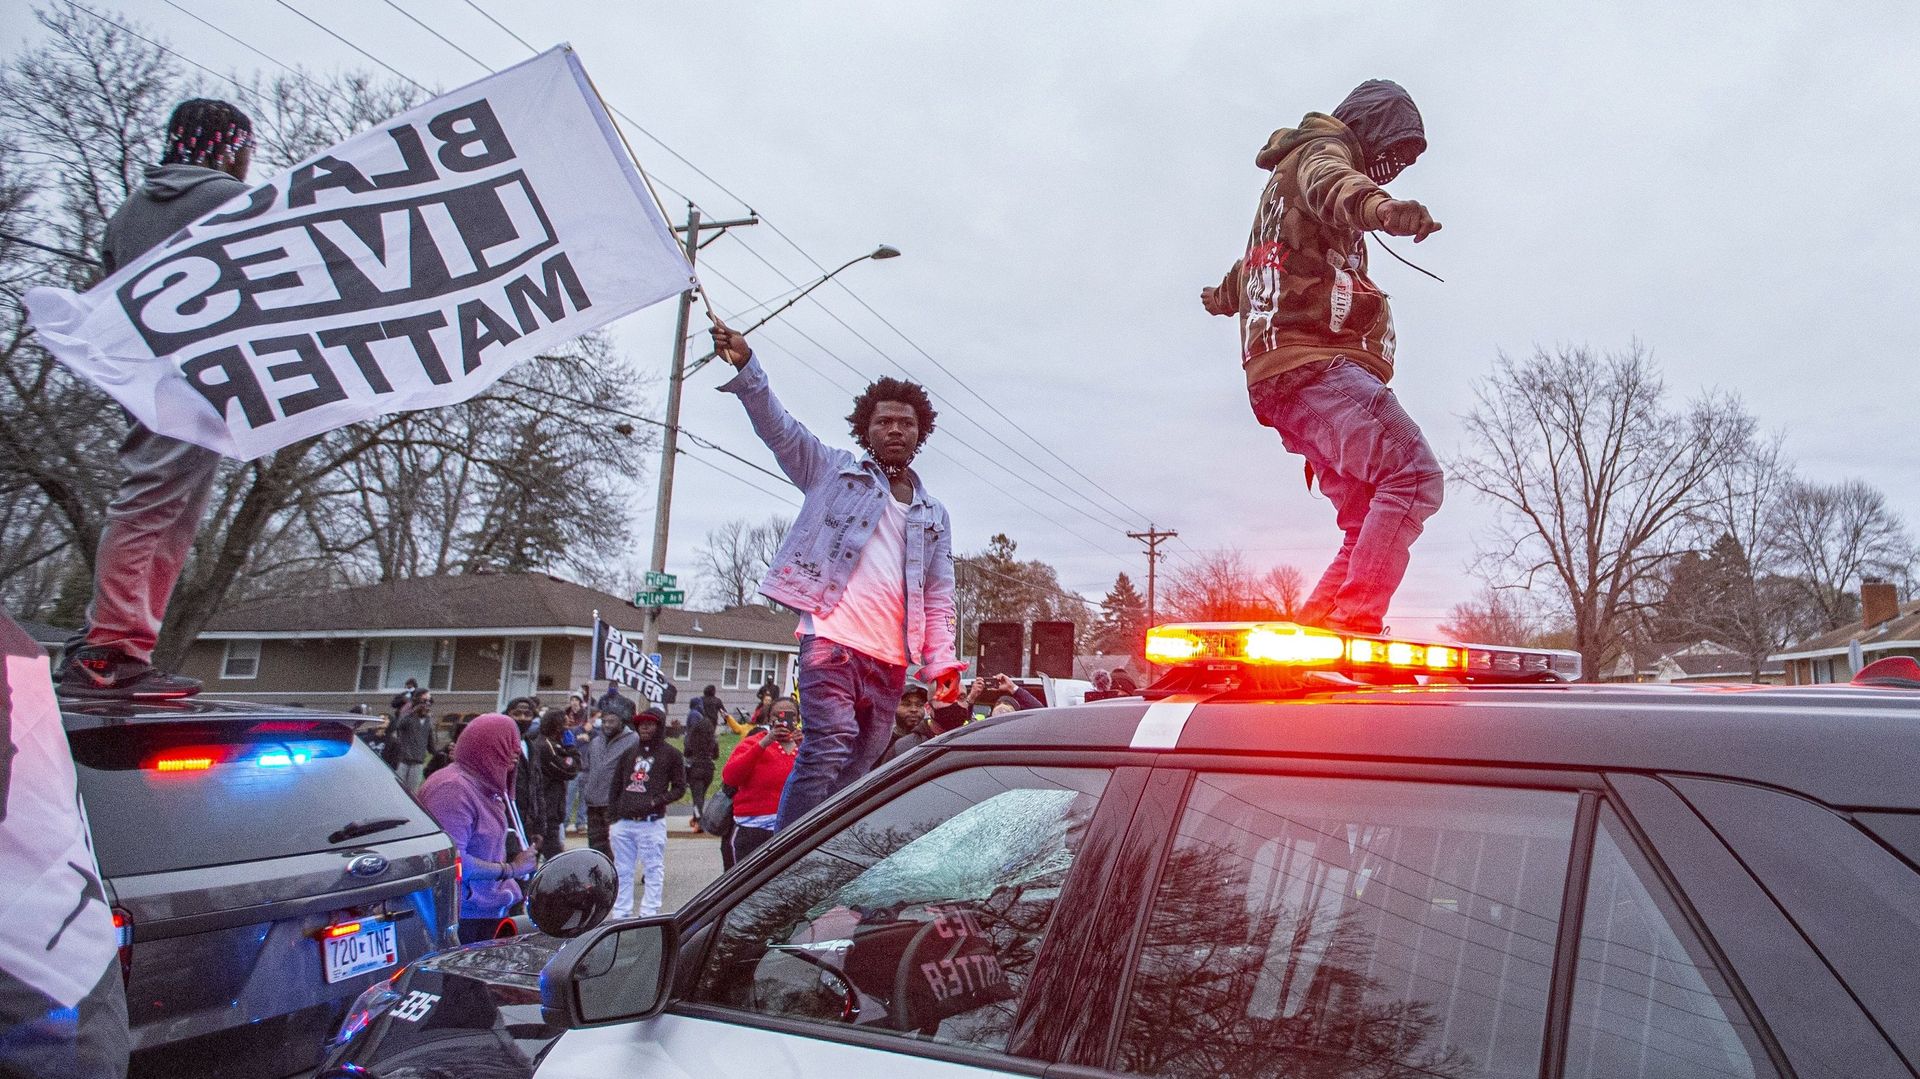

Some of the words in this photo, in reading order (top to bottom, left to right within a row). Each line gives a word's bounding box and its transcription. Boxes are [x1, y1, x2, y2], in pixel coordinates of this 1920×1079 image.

[651, 593, 665, 603] Lee
[606, 641, 666, 687] LIVES
[330, 936, 358, 968] 720
[367, 927, 392, 957] TNE
[389, 990, 442, 1022] 335
